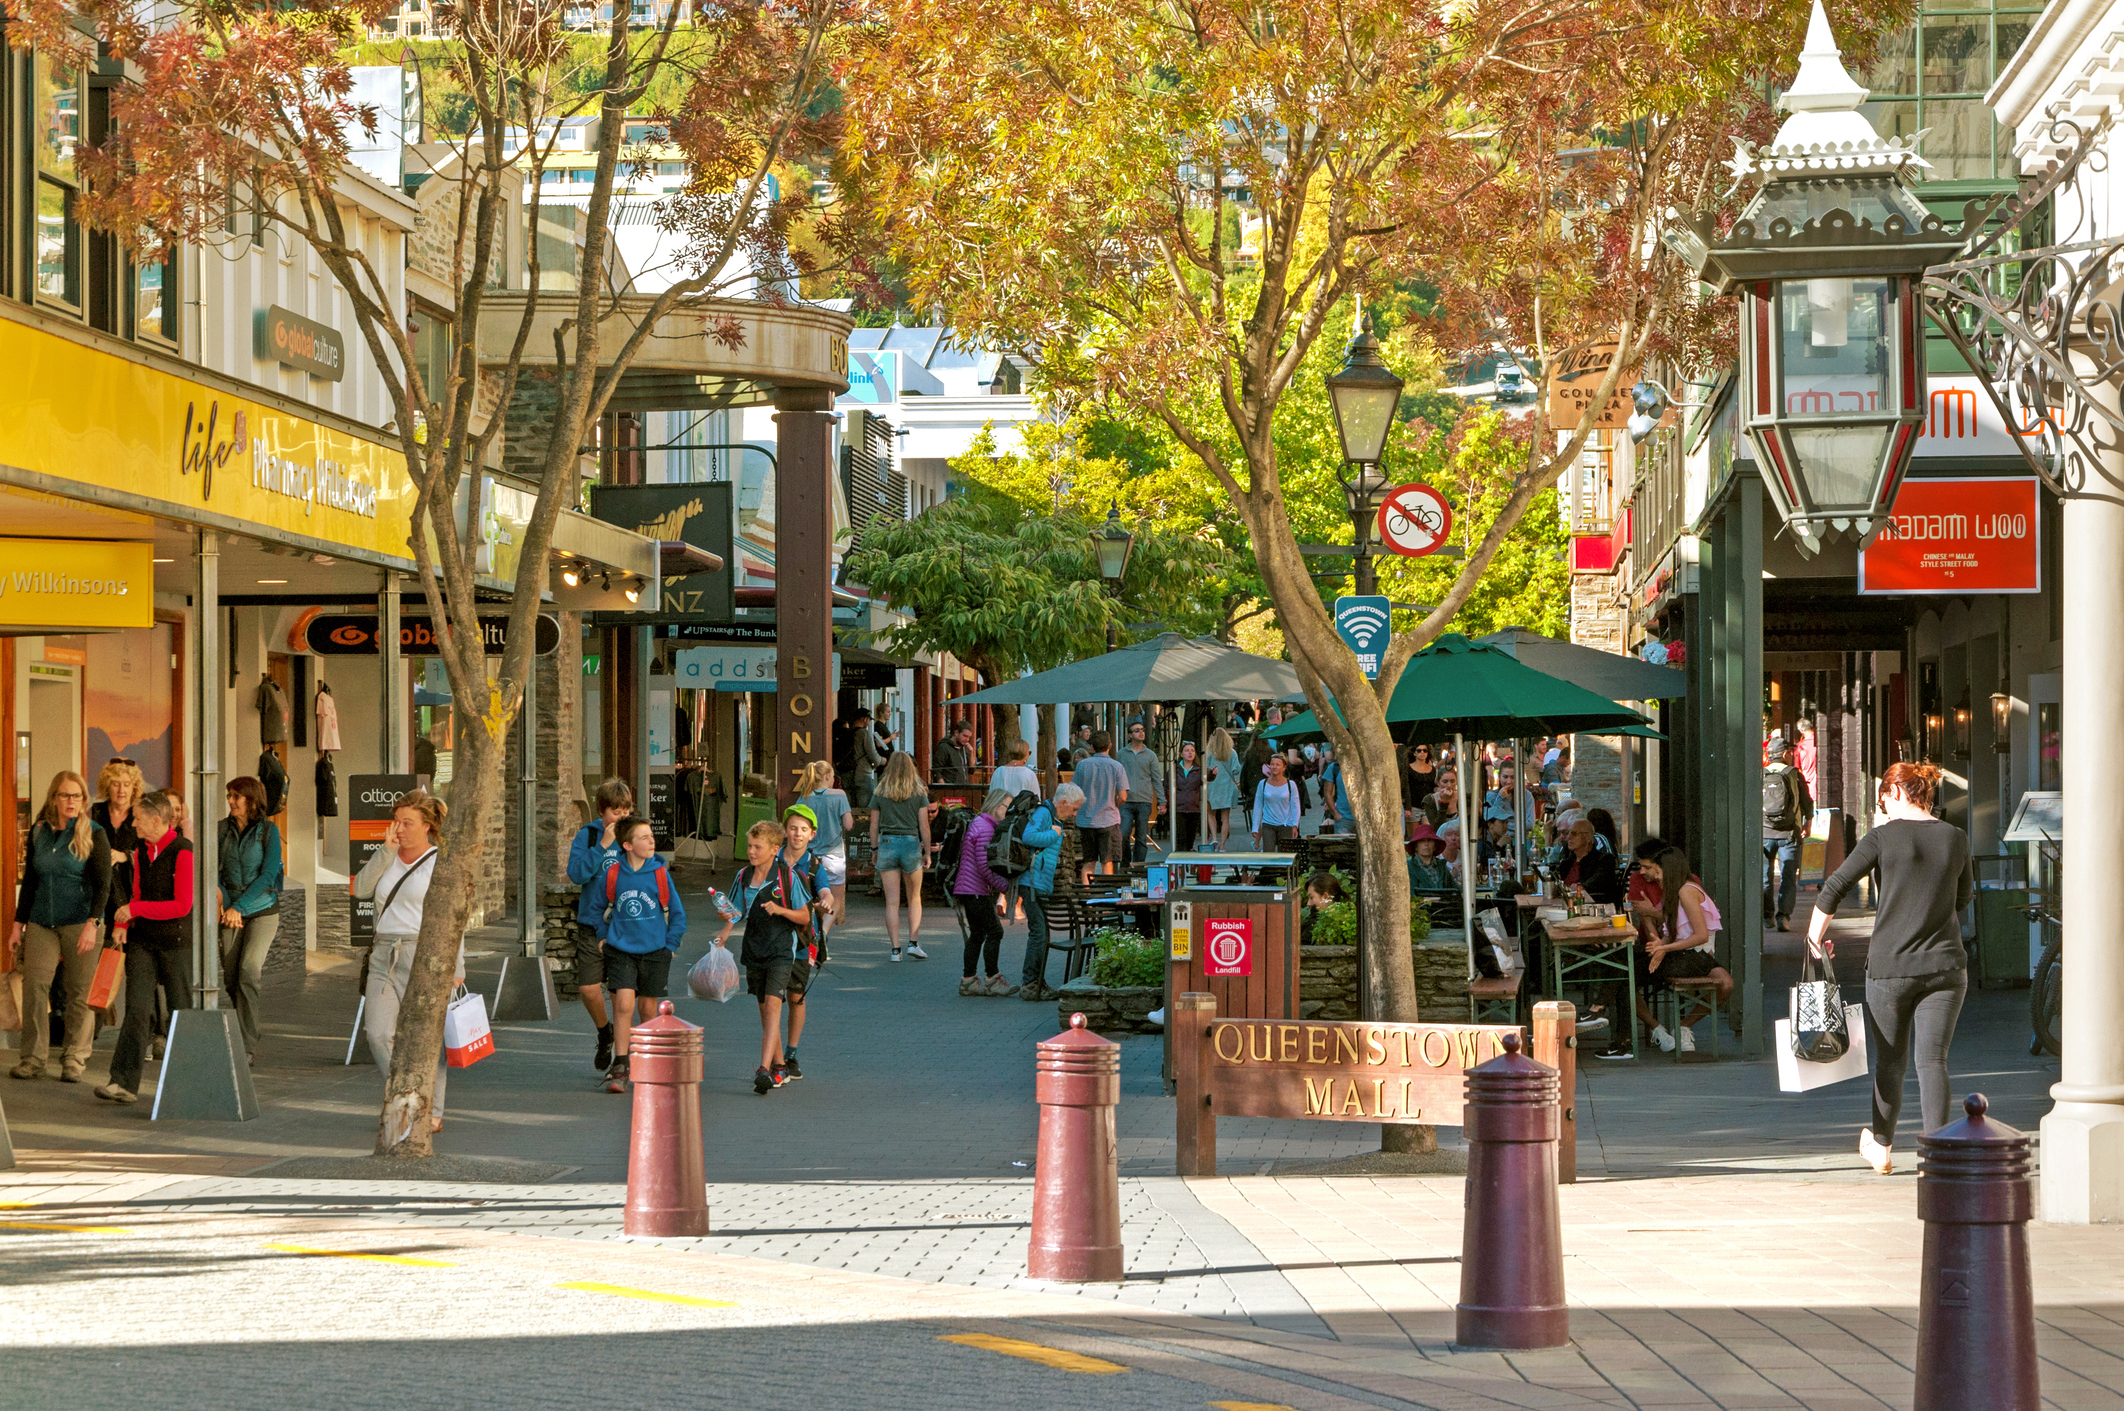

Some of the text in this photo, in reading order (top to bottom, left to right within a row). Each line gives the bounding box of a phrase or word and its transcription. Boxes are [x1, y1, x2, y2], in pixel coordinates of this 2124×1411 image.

[183, 401, 238, 501] life
[252, 437, 377, 519] Pharmacy Wilkinsons
[12, 571, 128, 596] Wilkinsons
[1338, 606, 1388, 620] QUEENSTOWN
[736, 628, 752, 636] The
[1356, 654, 1377, 662] REE
[1358, 663, 1377, 672] IFI
[1212, 922, 1245, 930] Rubbish
[1173, 943, 1189, 951] BIN
[1215, 966, 1241, 974] Landfill
[468, 1037, 487, 1052] SALE
[1303, 1077, 1421, 1119] MALL
